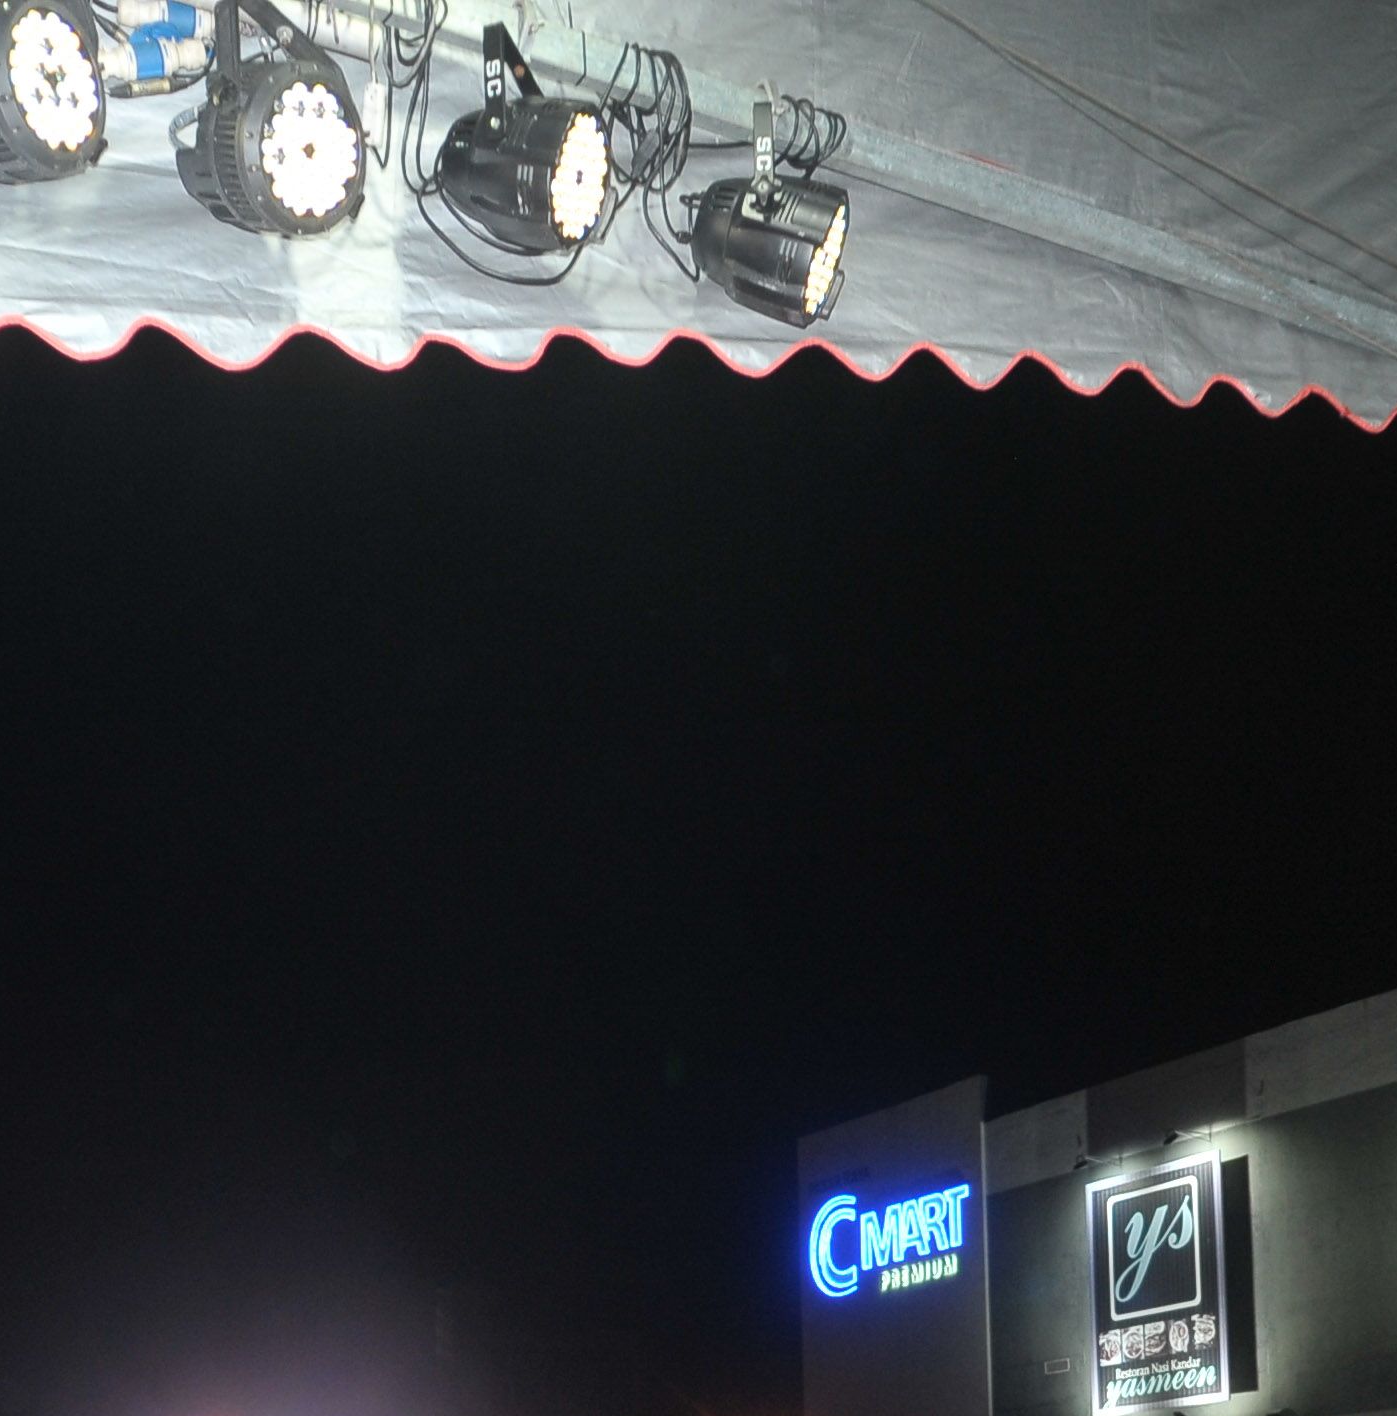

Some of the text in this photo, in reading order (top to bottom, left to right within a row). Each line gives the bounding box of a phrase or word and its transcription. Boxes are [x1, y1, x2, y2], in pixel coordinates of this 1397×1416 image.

[1115, 1194, 1194, 1302] ys
[880, 1253, 959, 1292] PREMIUM
[1104, 1365, 1217, 1408] yasmeen
[1115, 1356, 1201, 1380] Restoran Nasi Kandar
